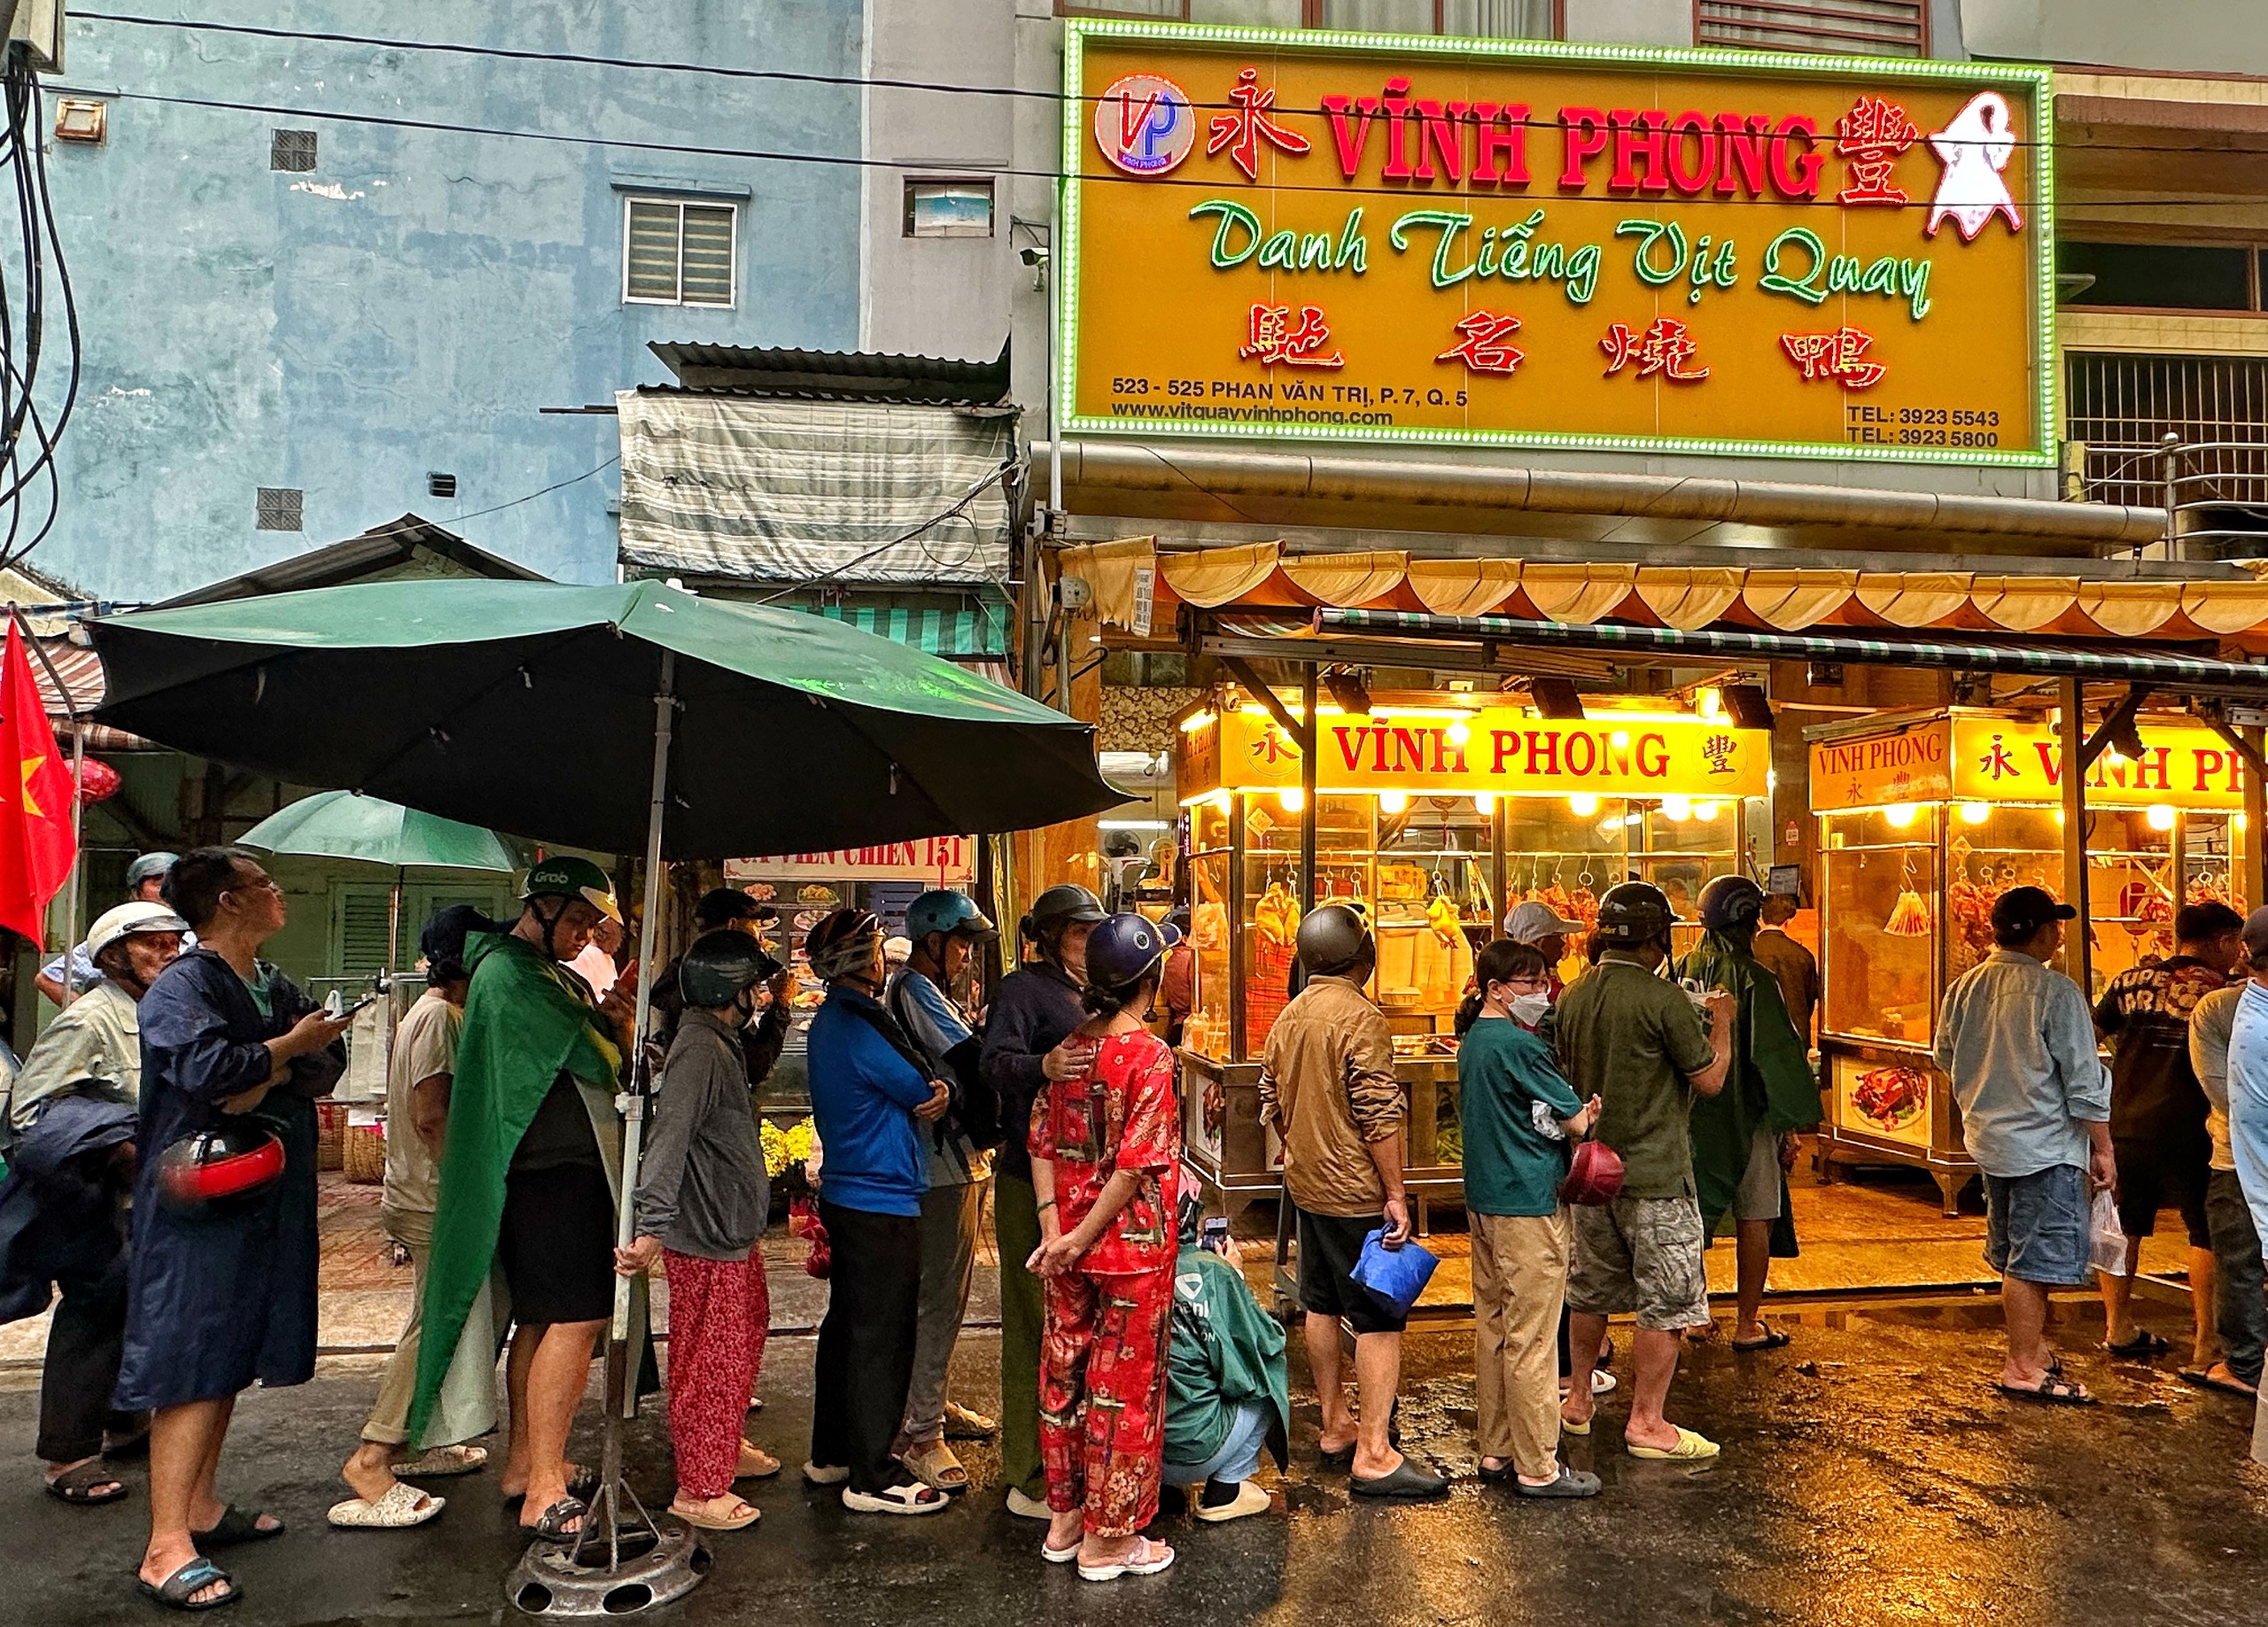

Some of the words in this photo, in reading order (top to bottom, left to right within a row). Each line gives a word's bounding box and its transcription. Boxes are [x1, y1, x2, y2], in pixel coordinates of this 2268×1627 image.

[1207, 66, 1311, 181] 永
[1557, 105, 1825, 199] PHONG
[1189, 199, 1368, 274] Danh
[1391, 207, 1602, 305] Tiếng
[1616, 219, 1739, 305] Vịt
[1759, 227, 1932, 321] Quay
[1433, 309, 1526, 373] 名
[1112, 377, 1149, 395] 523
[1168, 380, 1204, 397] 525
[1211, 381, 1273, 400] PHAN
[1281, 380, 1324, 401] VĂN
[1332, 386, 1374, 407] TRỊ,
[1426, 388, 1450, 406] Q.
[1456, 391, 1468, 407] 5
[1111, 402, 1394, 425] www.vitquayvinhphong.com
[1846, 406, 1894, 423] TEL:
[1899, 408, 1947, 425] 3923
[1952, 410, 2000, 426] 5543
[1846, 427, 1894, 444] TEL:
[1899, 429, 1946, 445] 3923
[1950, 430, 1999, 447] 5800
[1250, 723, 1300, 764] 永
[1332, 717, 1470, 772] VĨNH
[1490, 730, 1670, 778] PHONG
[1870, 733, 1943, 770] PHONG
[1979, 734, 2020, 781] 永
[2032, 733, 2172, 790] VNH
[925, 836, 961, 867] 151
[534, 871, 569, 884] Grab
